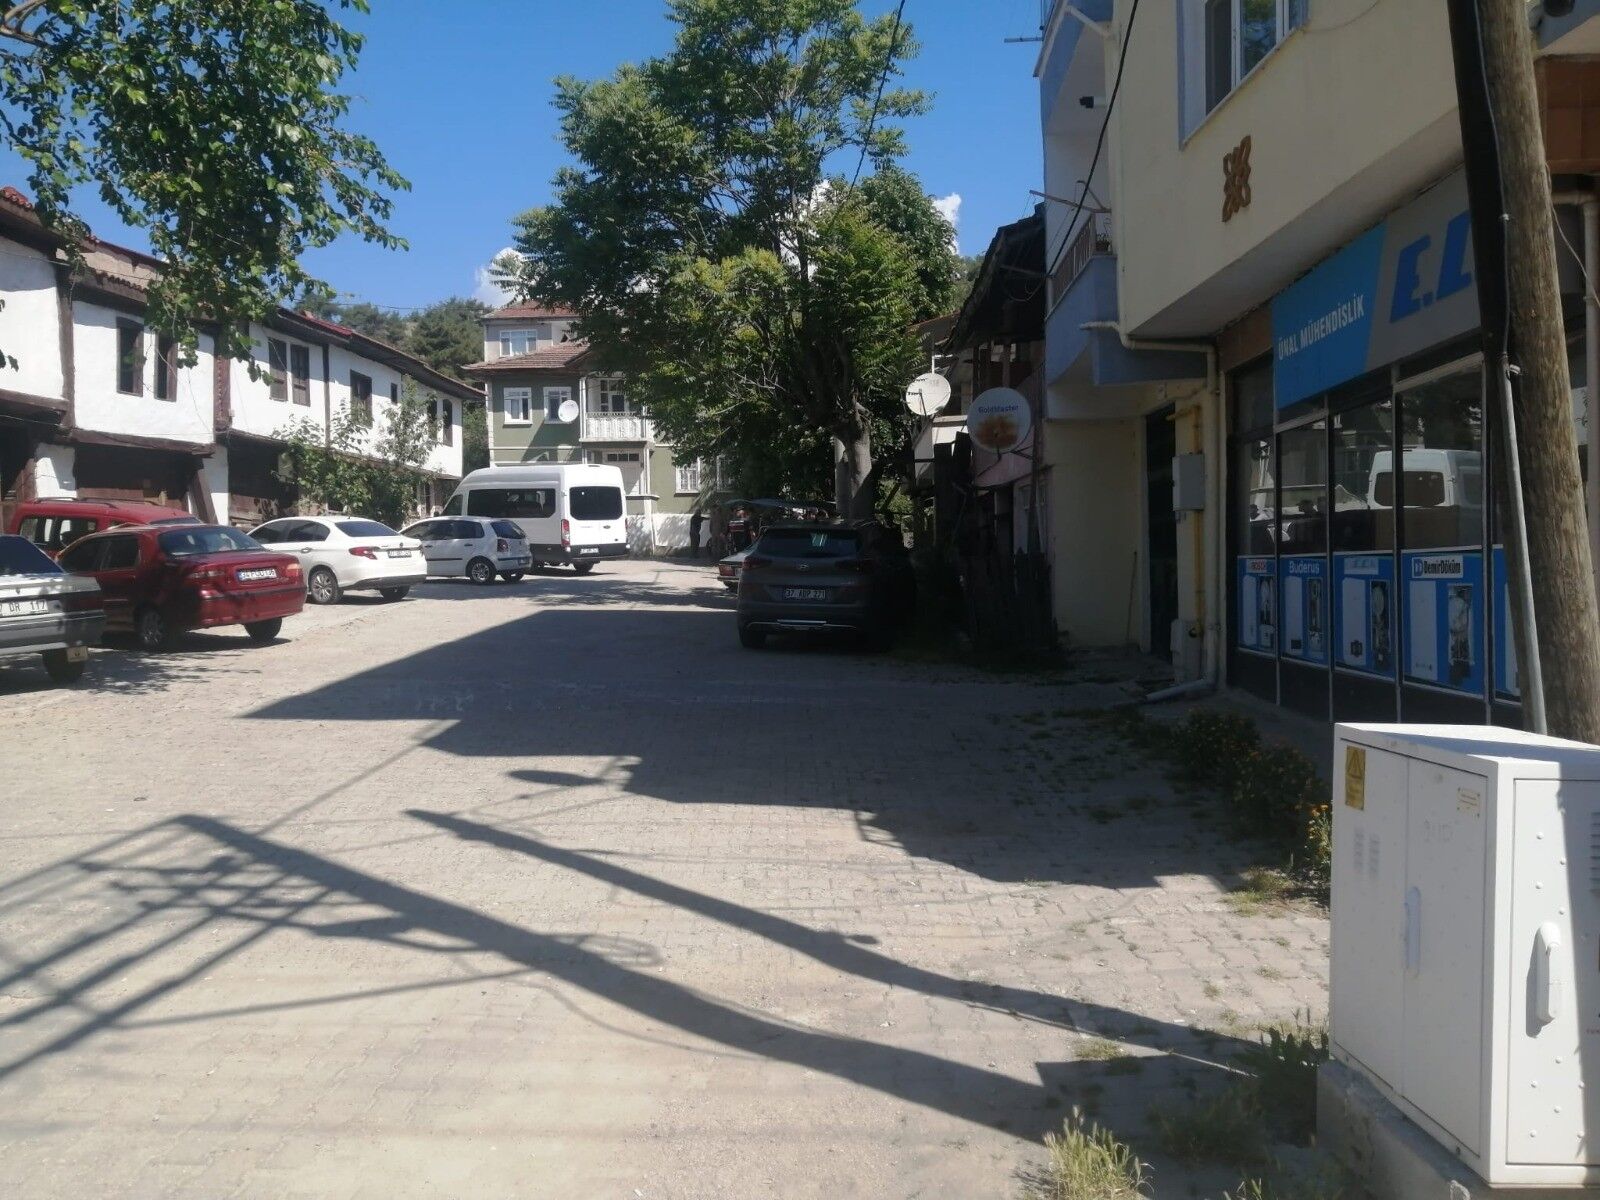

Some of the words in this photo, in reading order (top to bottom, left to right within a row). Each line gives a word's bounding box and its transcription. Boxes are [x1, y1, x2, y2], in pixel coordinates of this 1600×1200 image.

[1278, 334, 1299, 360] ÜNAL
[1300, 293, 1365, 348] MÜHENDİSLİK
[1289, 560, 1320, 574] Buderus
